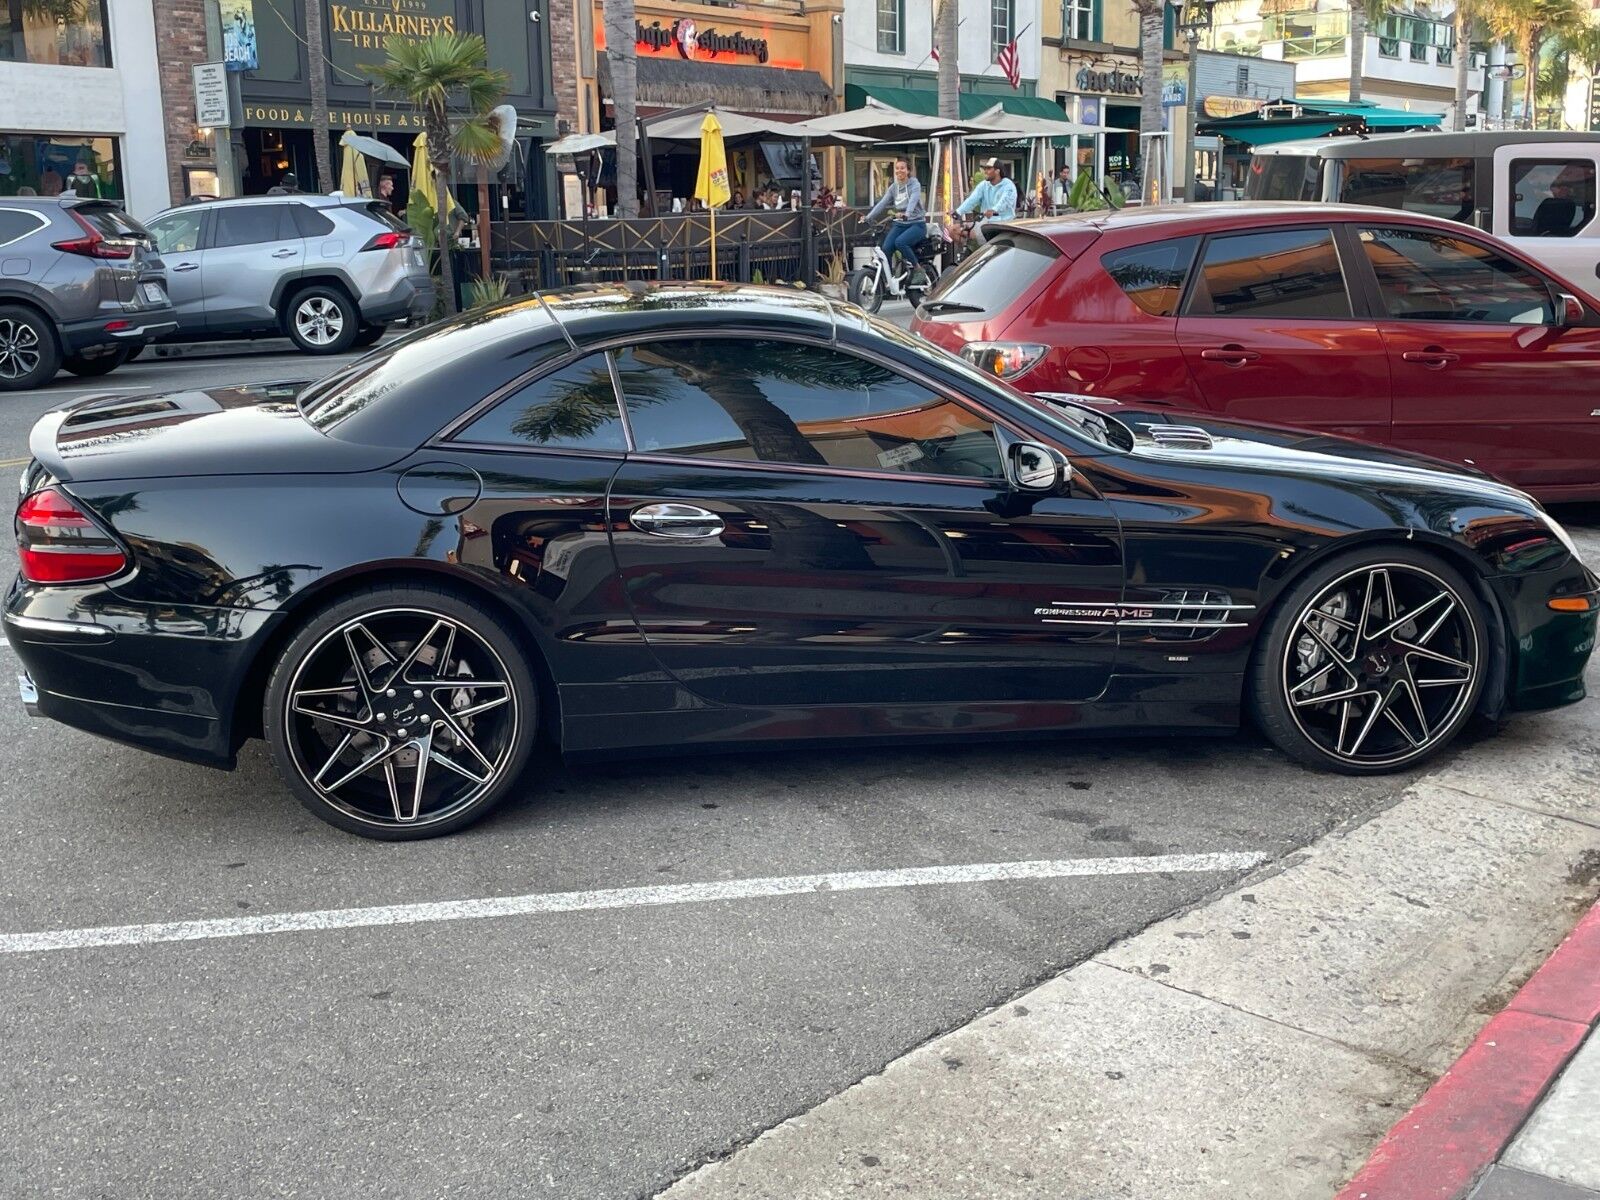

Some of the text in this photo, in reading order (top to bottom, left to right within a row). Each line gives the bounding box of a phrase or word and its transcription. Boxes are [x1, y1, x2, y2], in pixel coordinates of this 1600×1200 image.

[402, 0, 427, 10] 1999
[331, 4, 454, 36] KILLARNEY'S
[353, 34, 390, 49] IRIS
[246, 107, 290, 121] FOOD
[342, 111, 391, 126] HOUSE
[1034, 607, 1154, 618] KOMPRESSOR AMG
